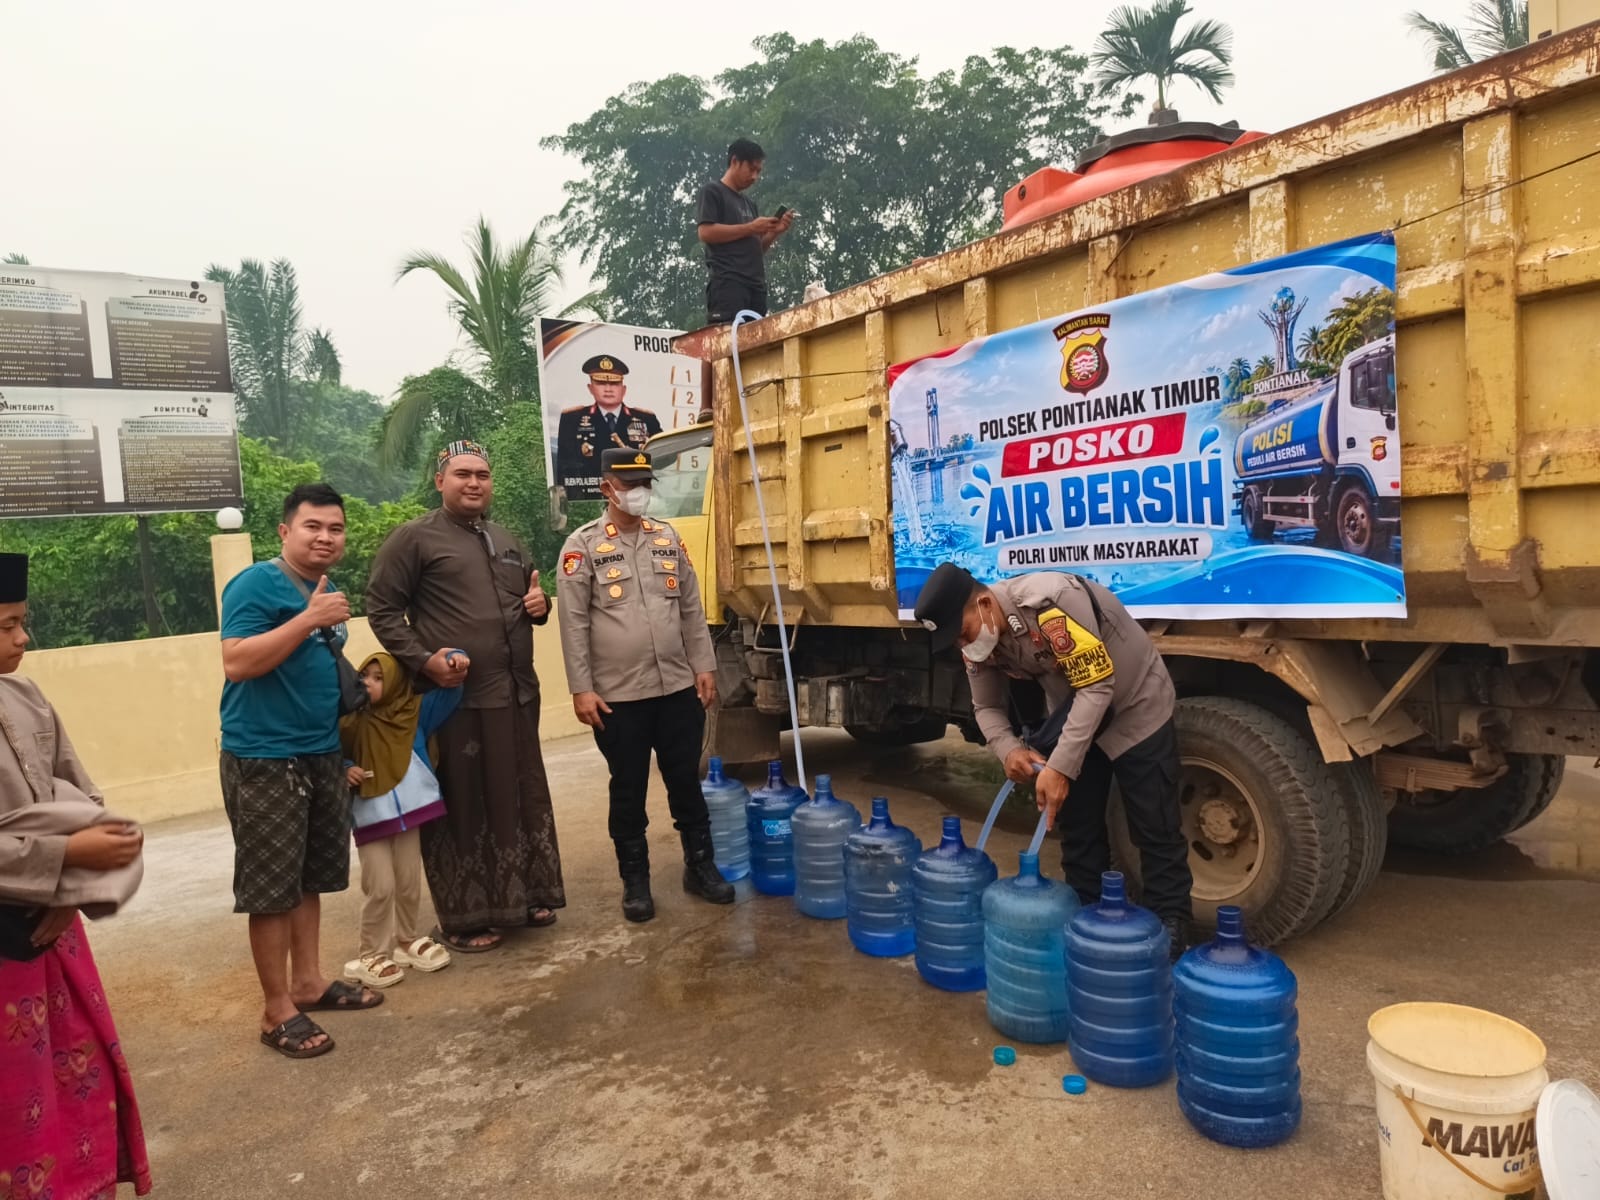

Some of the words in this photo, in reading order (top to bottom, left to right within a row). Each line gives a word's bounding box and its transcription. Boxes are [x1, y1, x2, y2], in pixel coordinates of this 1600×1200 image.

[148, 289, 188, 298] AKUNTABEL
[1057, 318, 1089, 337] KALIMANTAN
[1088, 315, 1108, 326] BARAT
[633, 334, 673, 354] PROG
[685, 369, 692, 383] 1
[1253, 369, 1310, 395] PONTIANAK
[686, 391, 695, 405] 2
[979, 410, 1038, 442] POLSEK
[1041, 389, 1146, 431] PONTIANAK
[1151, 375, 1221, 411] TIMUR
[688, 412, 696, 426] 3
[1028, 423, 1155, 470] POSKO
[1252, 420, 1294, 454] POLISI
[690, 455, 699, 469] 5
[1247, 453, 1265, 468] PEDULI
[1265, 451, 1276, 464] AIR
[1276, 443, 1307, 460] BERSIH
[984, 481, 1054, 545] AIR
[1060, 457, 1226, 530] BERSIH
[594, 554, 625, 567] SURYADI
[651, 549, 678, 557] POLRI
[1008, 548, 1045, 566] POLRI
[1050, 544, 1090, 563] UNTUK
[1093, 537, 1200, 561] MASYARAKAT
[1422, 1116, 1538, 1158] MAWA
[1503, 1158, 1526, 1173] Cat
